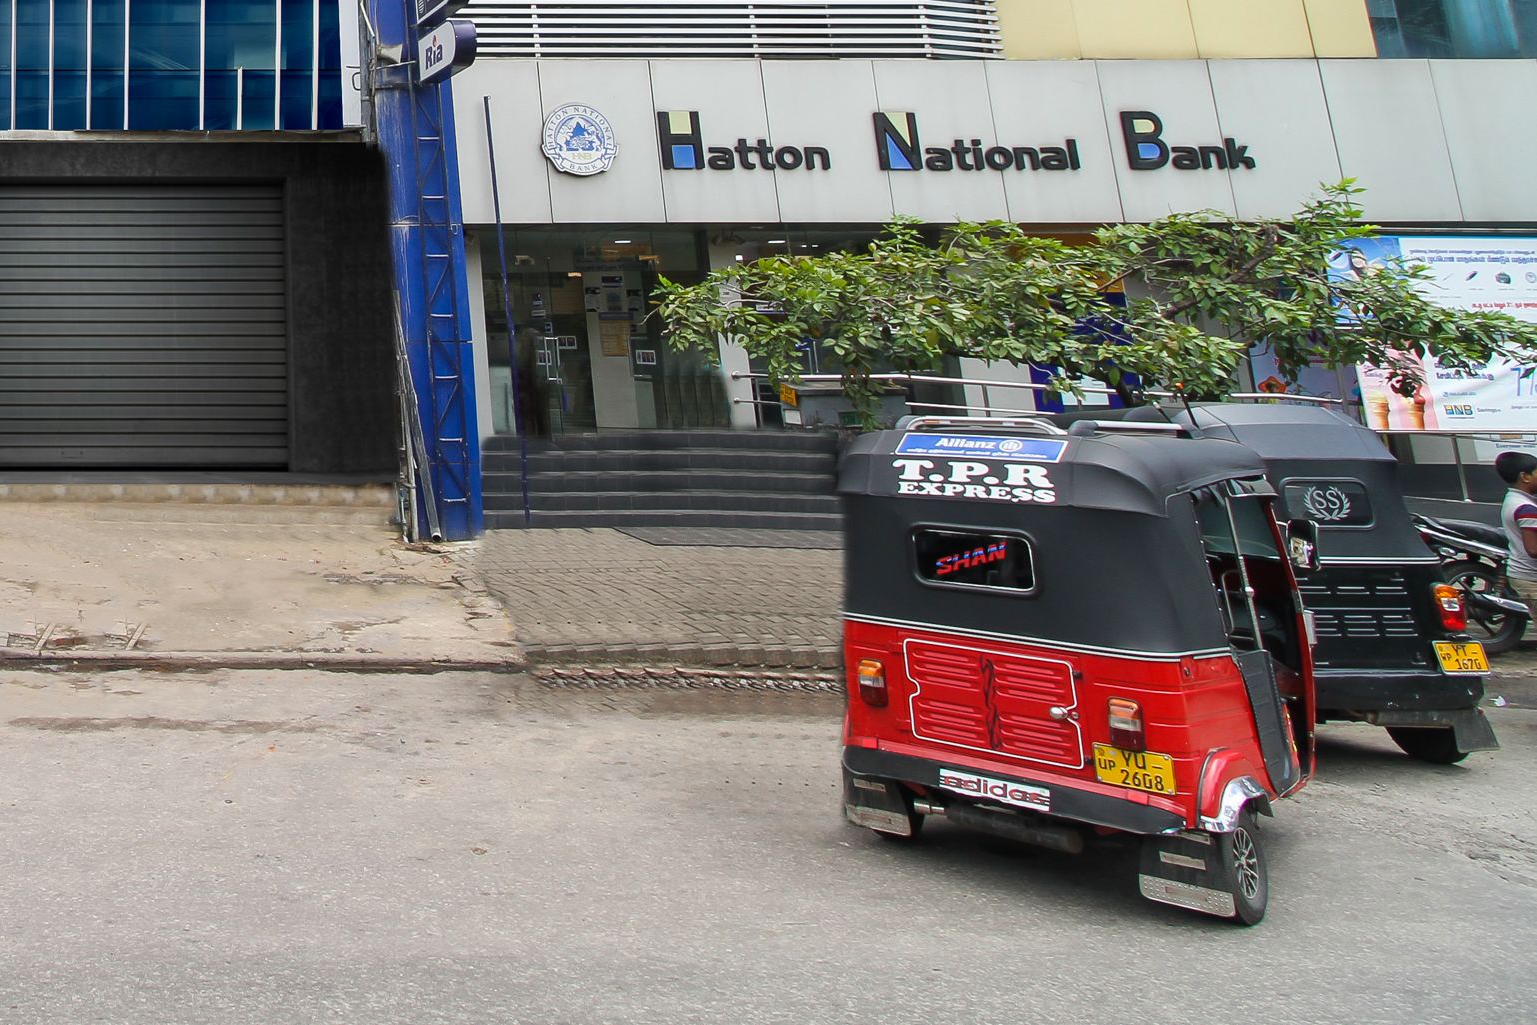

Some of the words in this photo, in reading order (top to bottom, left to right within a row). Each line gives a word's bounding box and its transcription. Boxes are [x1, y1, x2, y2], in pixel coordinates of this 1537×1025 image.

[425, 40, 444, 71] Ria
[546, 108, 569, 149] HATTON
[573, 106, 612, 147] NATIONAL
[657, 111, 831, 171] Hatton
[872, 111, 1081, 172] National
[1119, 111, 1256, 171] Bank
[569, 163, 599, 172] BANK
[1443, 404, 1474, 416] HNB
[935, 437, 997, 450] Allianz
[892, 459, 1055, 488] T.P.R
[897, 481, 1056, 503] EXPRESS
[1314, 489, 1341, 510] SS
[935, 540, 1008, 575] SHAN
[1439, 652, 1452, 661] WP
[1098, 757, 1116, 771] UP
[1120, 750, 1147, 770] YU
[943, 774, 1044, 805] adidas
